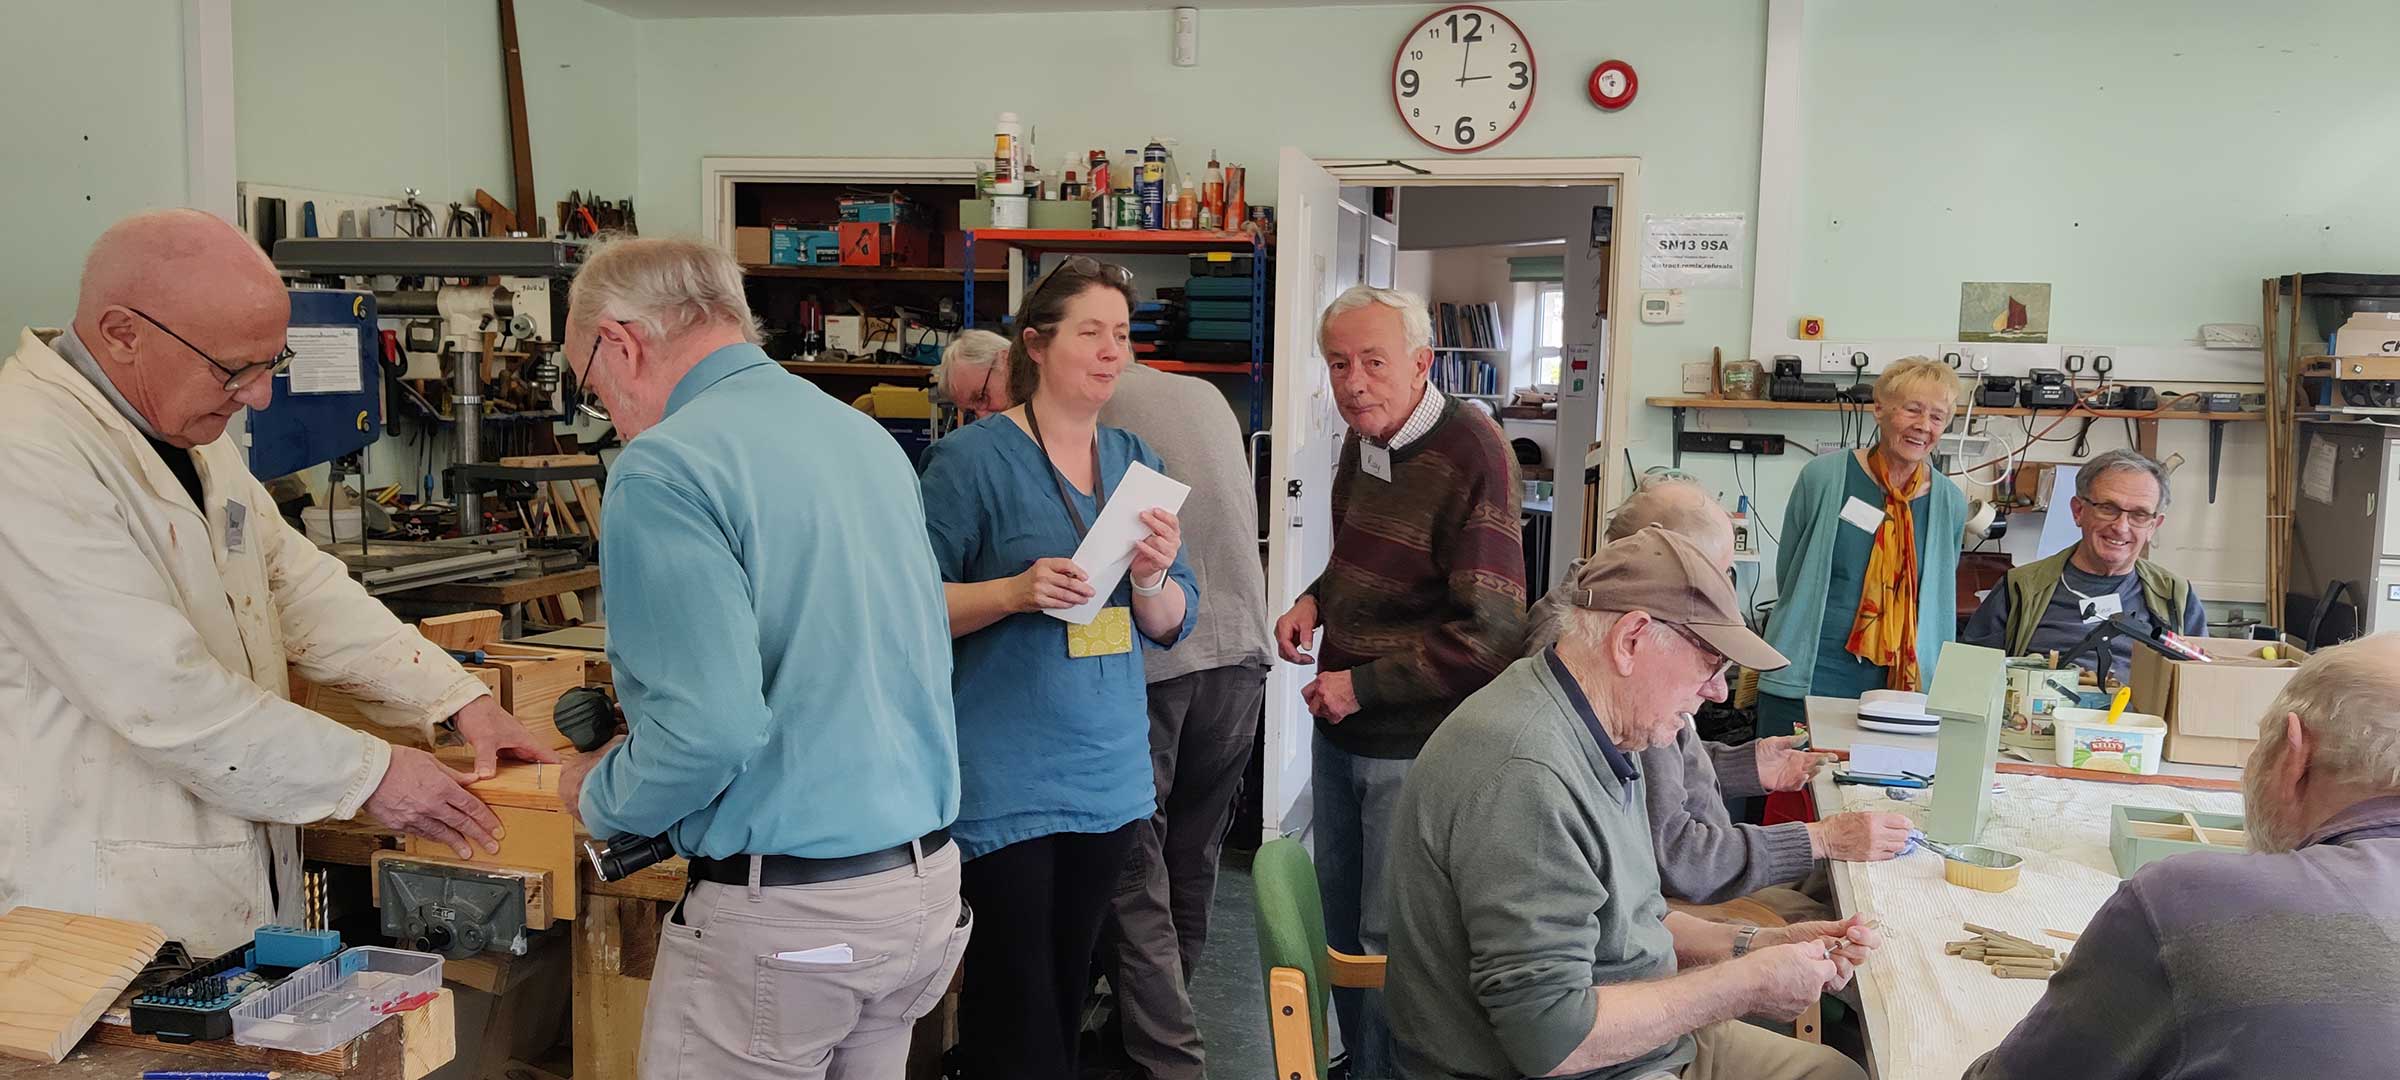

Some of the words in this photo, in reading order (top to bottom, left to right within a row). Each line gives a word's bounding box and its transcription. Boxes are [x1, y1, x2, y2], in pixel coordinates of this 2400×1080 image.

[1445, 13, 1482, 43] 12
[1489, 24, 1495, 34] 1
[1428, 28, 1440, 39] 11
[1510, 43, 1517, 53] 2
[1410, 50, 1423, 60] 10
[1507, 61, 1529, 90] 3
[1400, 69, 1420, 98] 9
[1509, 101, 1517, 111] 4
[1413, 108, 1420, 118] 8
[1434, 125, 1441, 135] 7
[1454, 116, 1475, 144] 6
[1489, 121, 1497, 132] 5
[1659, 240, 1696, 251] SN13
[1700, 240, 1729, 251] 9SA
[2091, 742, 2123, 750] KELLY'S
